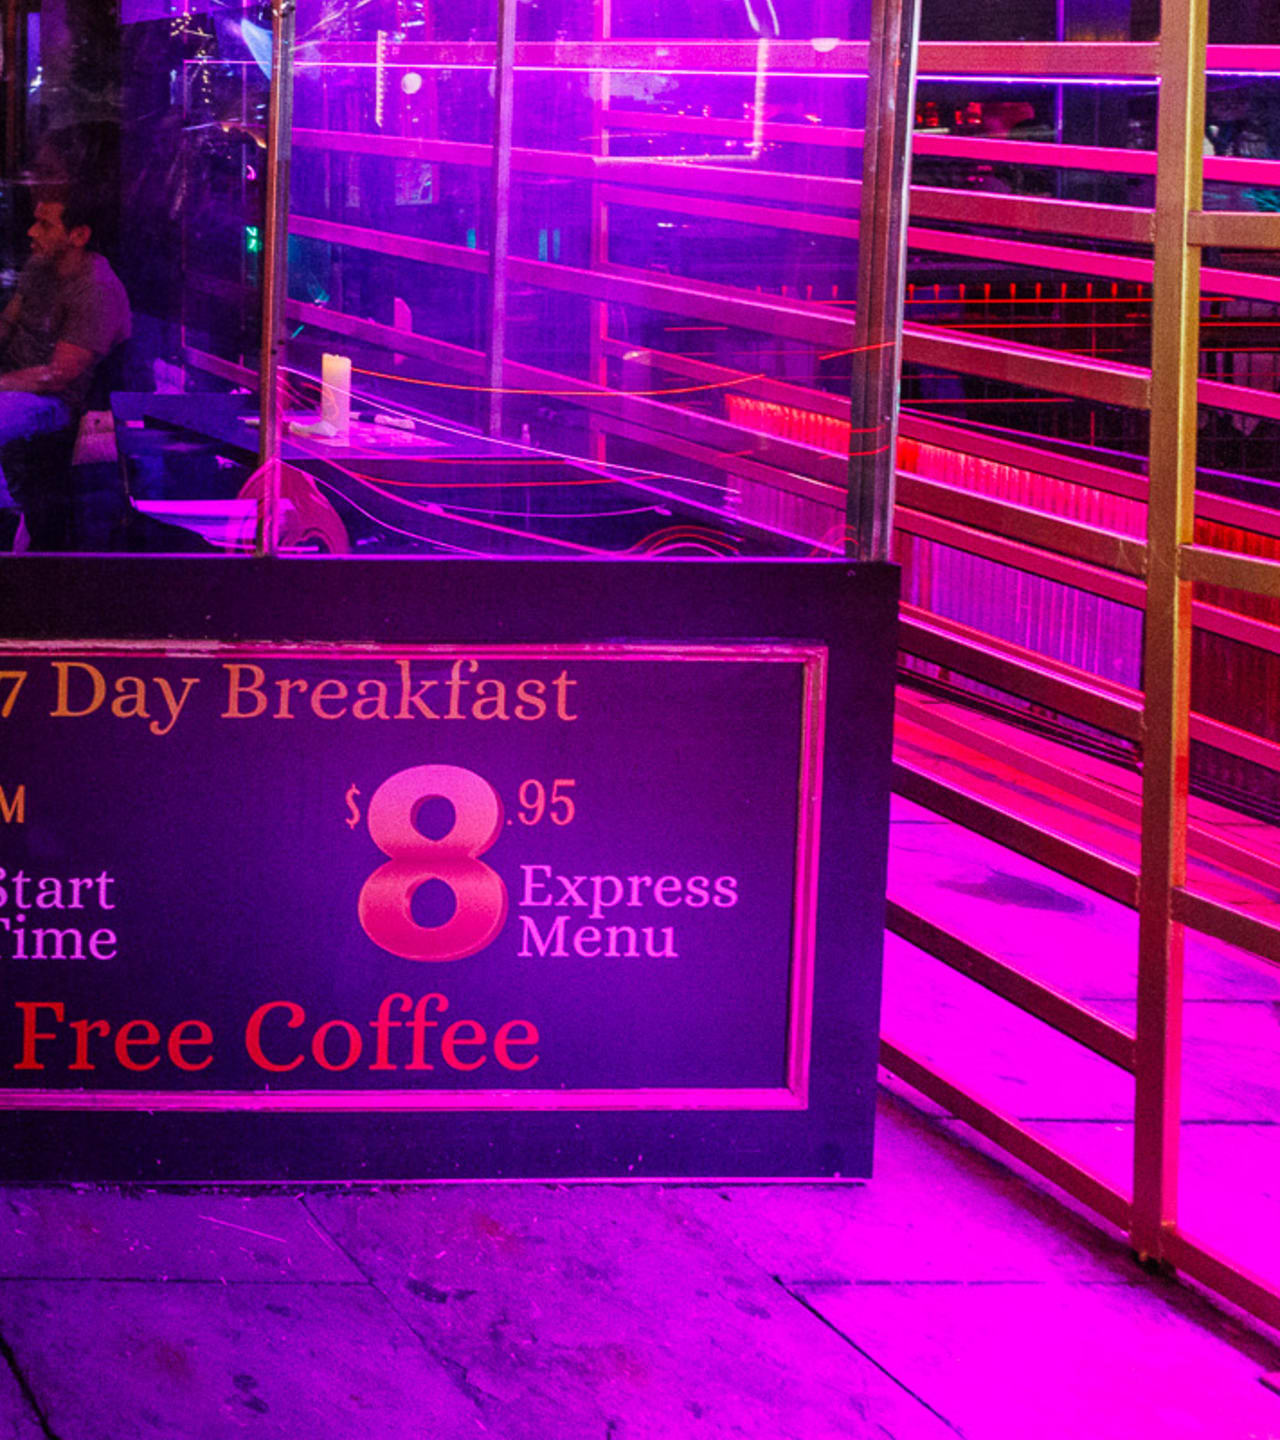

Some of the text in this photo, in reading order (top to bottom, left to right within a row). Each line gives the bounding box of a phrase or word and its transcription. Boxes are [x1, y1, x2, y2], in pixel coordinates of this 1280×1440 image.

[49, 661, 200, 736] Day
[220, 660, 579, 722] Breakfast
[518, 864, 739, 919] Express
[517, 915, 680, 958] Menu
[13, 992, 540, 1073] Free Coffee
